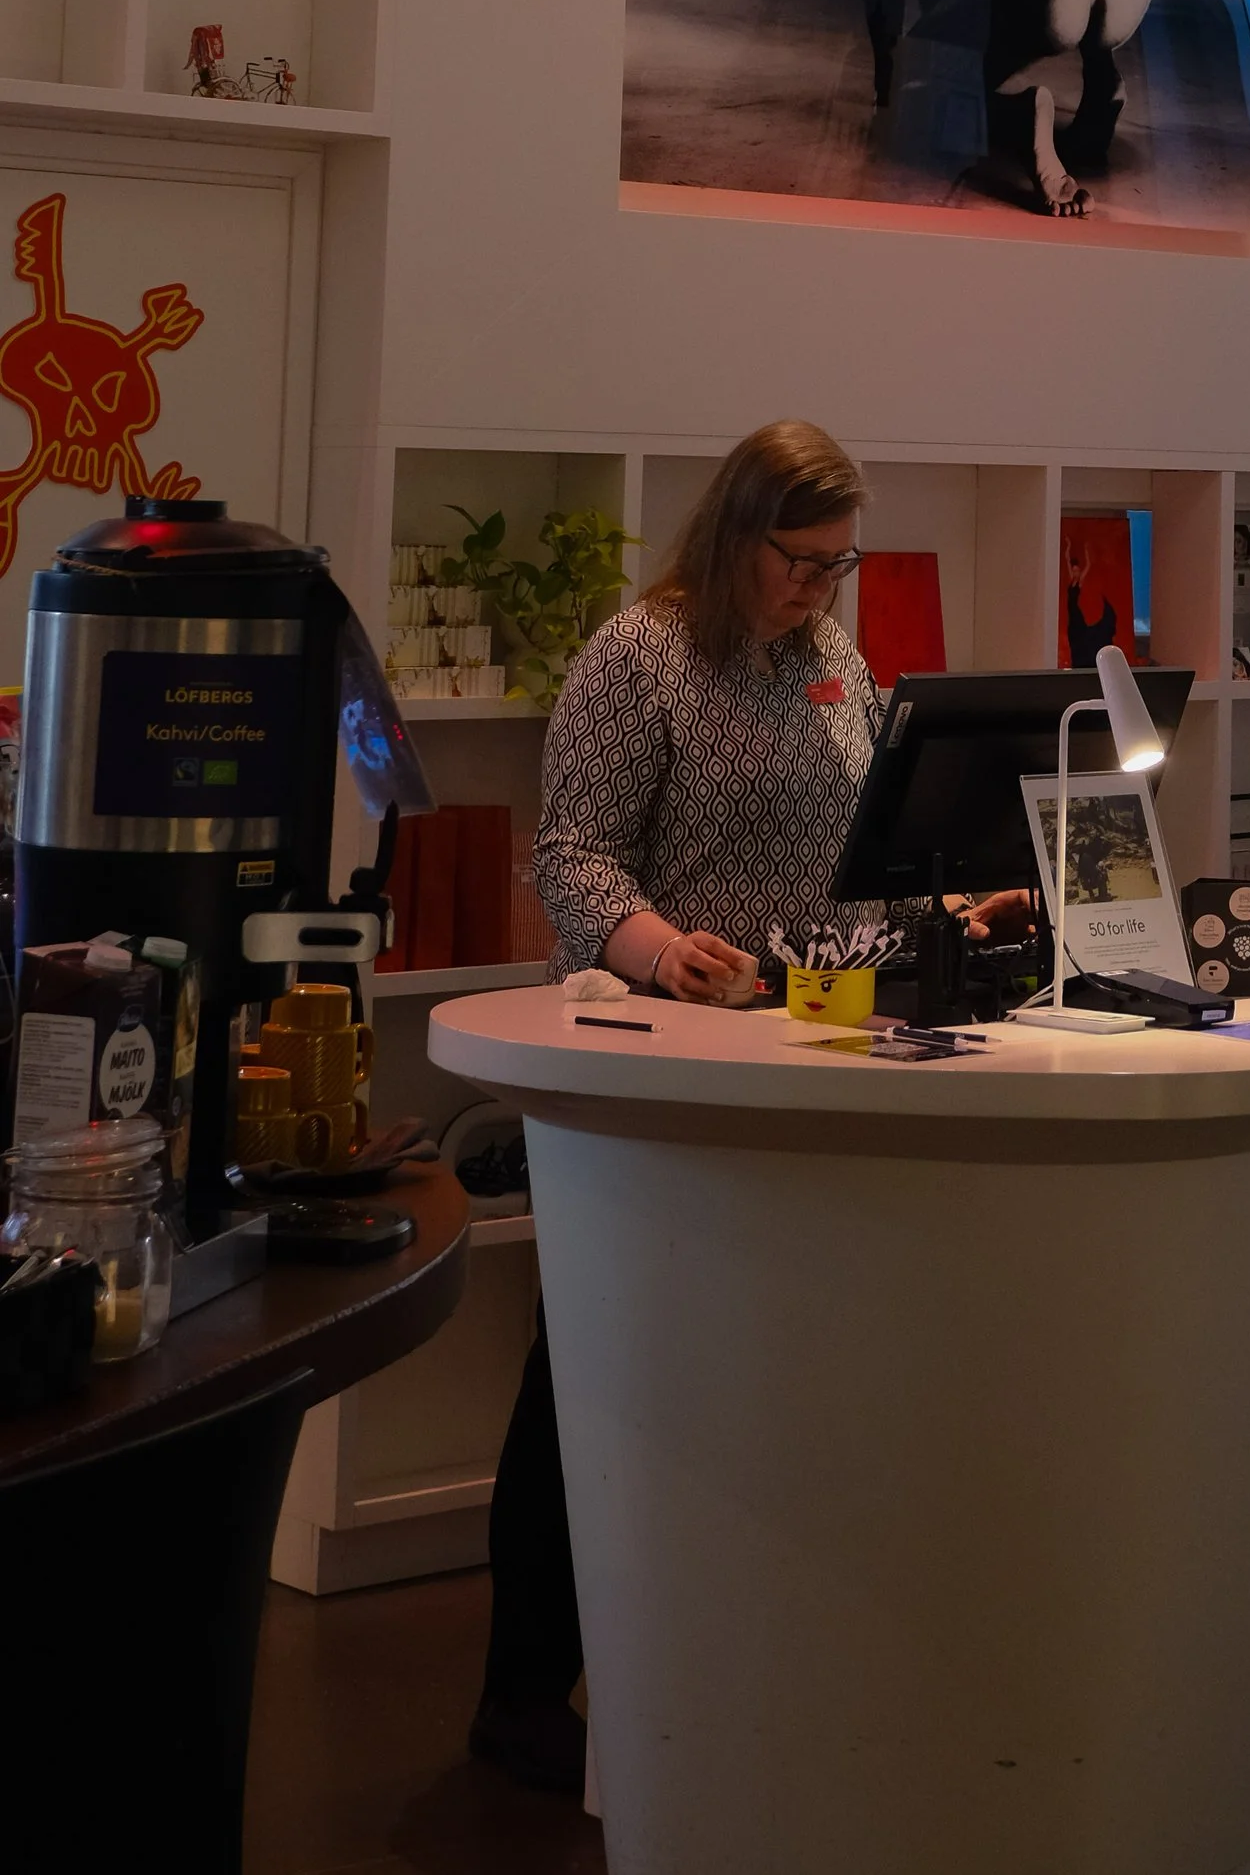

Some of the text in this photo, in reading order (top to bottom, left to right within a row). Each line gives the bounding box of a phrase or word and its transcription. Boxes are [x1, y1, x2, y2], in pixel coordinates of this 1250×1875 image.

[164, 686, 254, 705] LÖFBERGS
[145, 723, 267, 742] Kahvi/Coffee
[1088, 918, 1146, 937] 50 for life
[110, 1047, 146, 1070] MAITO
[108, 1080, 146, 1104] MJÖLK
